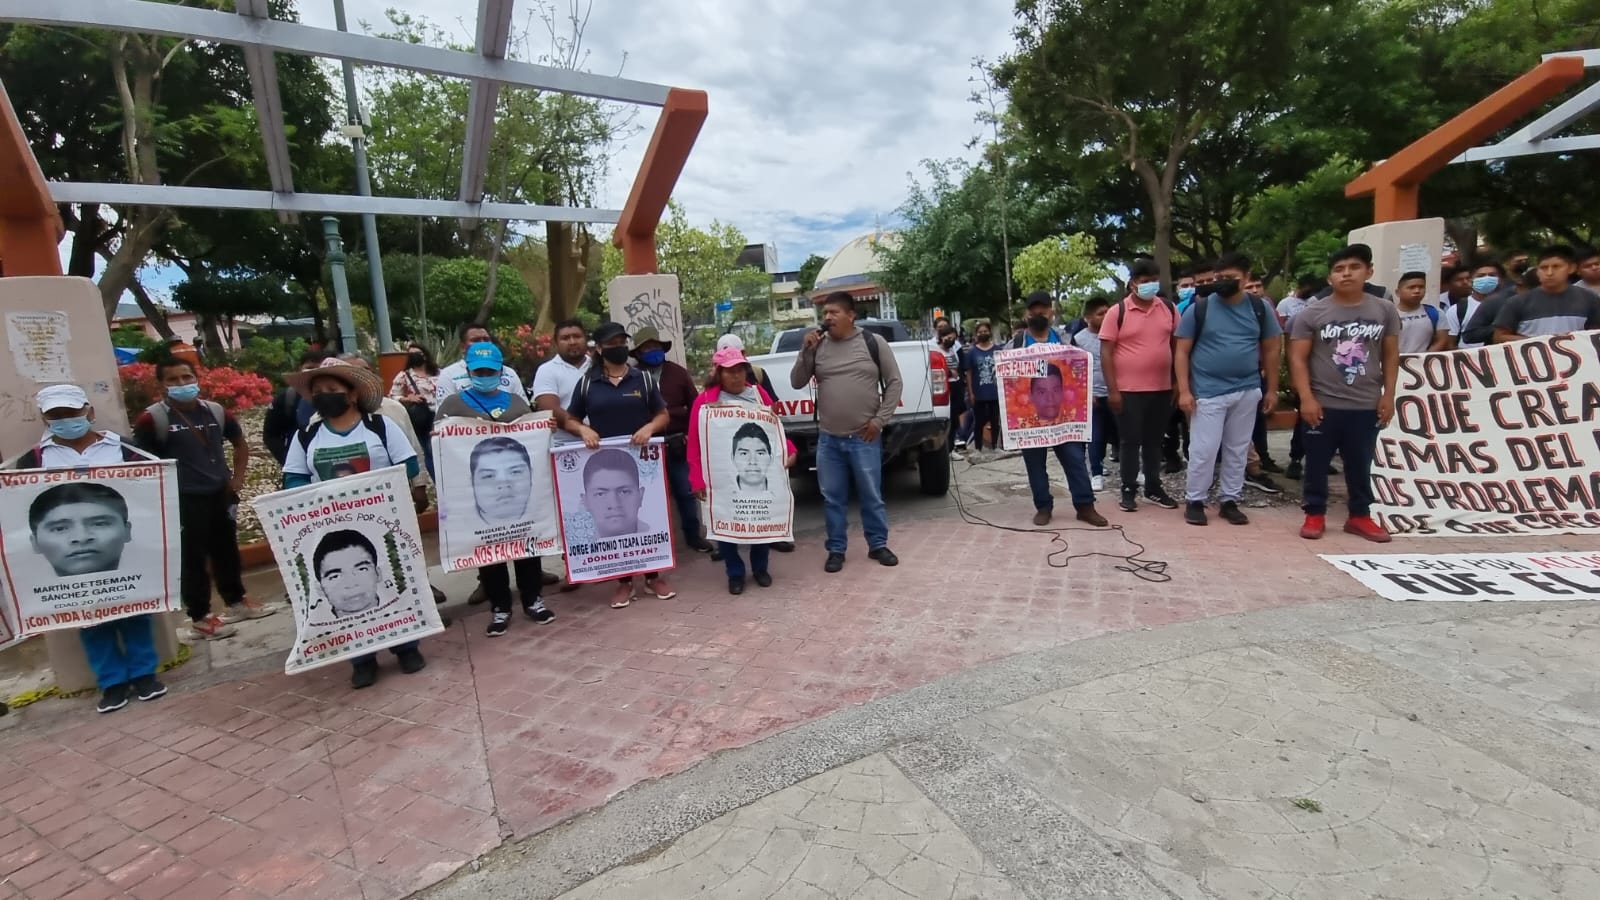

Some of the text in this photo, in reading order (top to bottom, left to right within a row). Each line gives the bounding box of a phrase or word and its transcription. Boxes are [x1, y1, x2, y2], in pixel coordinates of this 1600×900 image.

[1320, 322, 1384, 340] NOT TODAY!
[1012, 360, 1037, 376] FALTAN
[1398, 348, 1499, 391] SON
[1503, 334, 1582, 386] LOS
[735, 409, 746, 418] se
[1395, 392, 1481, 440] QUE
[441, 424, 473, 438] ¡Vivo
[475, 424, 488, 436] se
[490, 423, 501, 434] lo
[640, 445, 660, 461] 43
[1505, 432, 1585, 471] DEL
[44, 472, 62, 483] se
[332, 493, 385, 513] llevaron!
[356, 513, 376, 522] POR
[730, 521, 747, 533] VIDA
[474, 544, 494, 564] NOS
[494, 538, 526, 561] FALTAN
[568, 543, 590, 557] JORGE
[590, 540, 618, 554] ANTONIO
[618, 536, 640, 550] TIZAPA
[1340, 559, 1394, 571] YA
[1399, 559, 1466, 571] SEA
[1463, 558, 1531, 571] POR
[33, 574, 143, 594] MARTÍN GETSEMANY
[1381, 572, 1515, 596] FUE
[26, 598, 160, 630] ¡Con VIDA lo queremos!
[54, 601, 79, 609] EDAD
[303, 614, 417, 657] ¡Con VIDA lo queremos!
